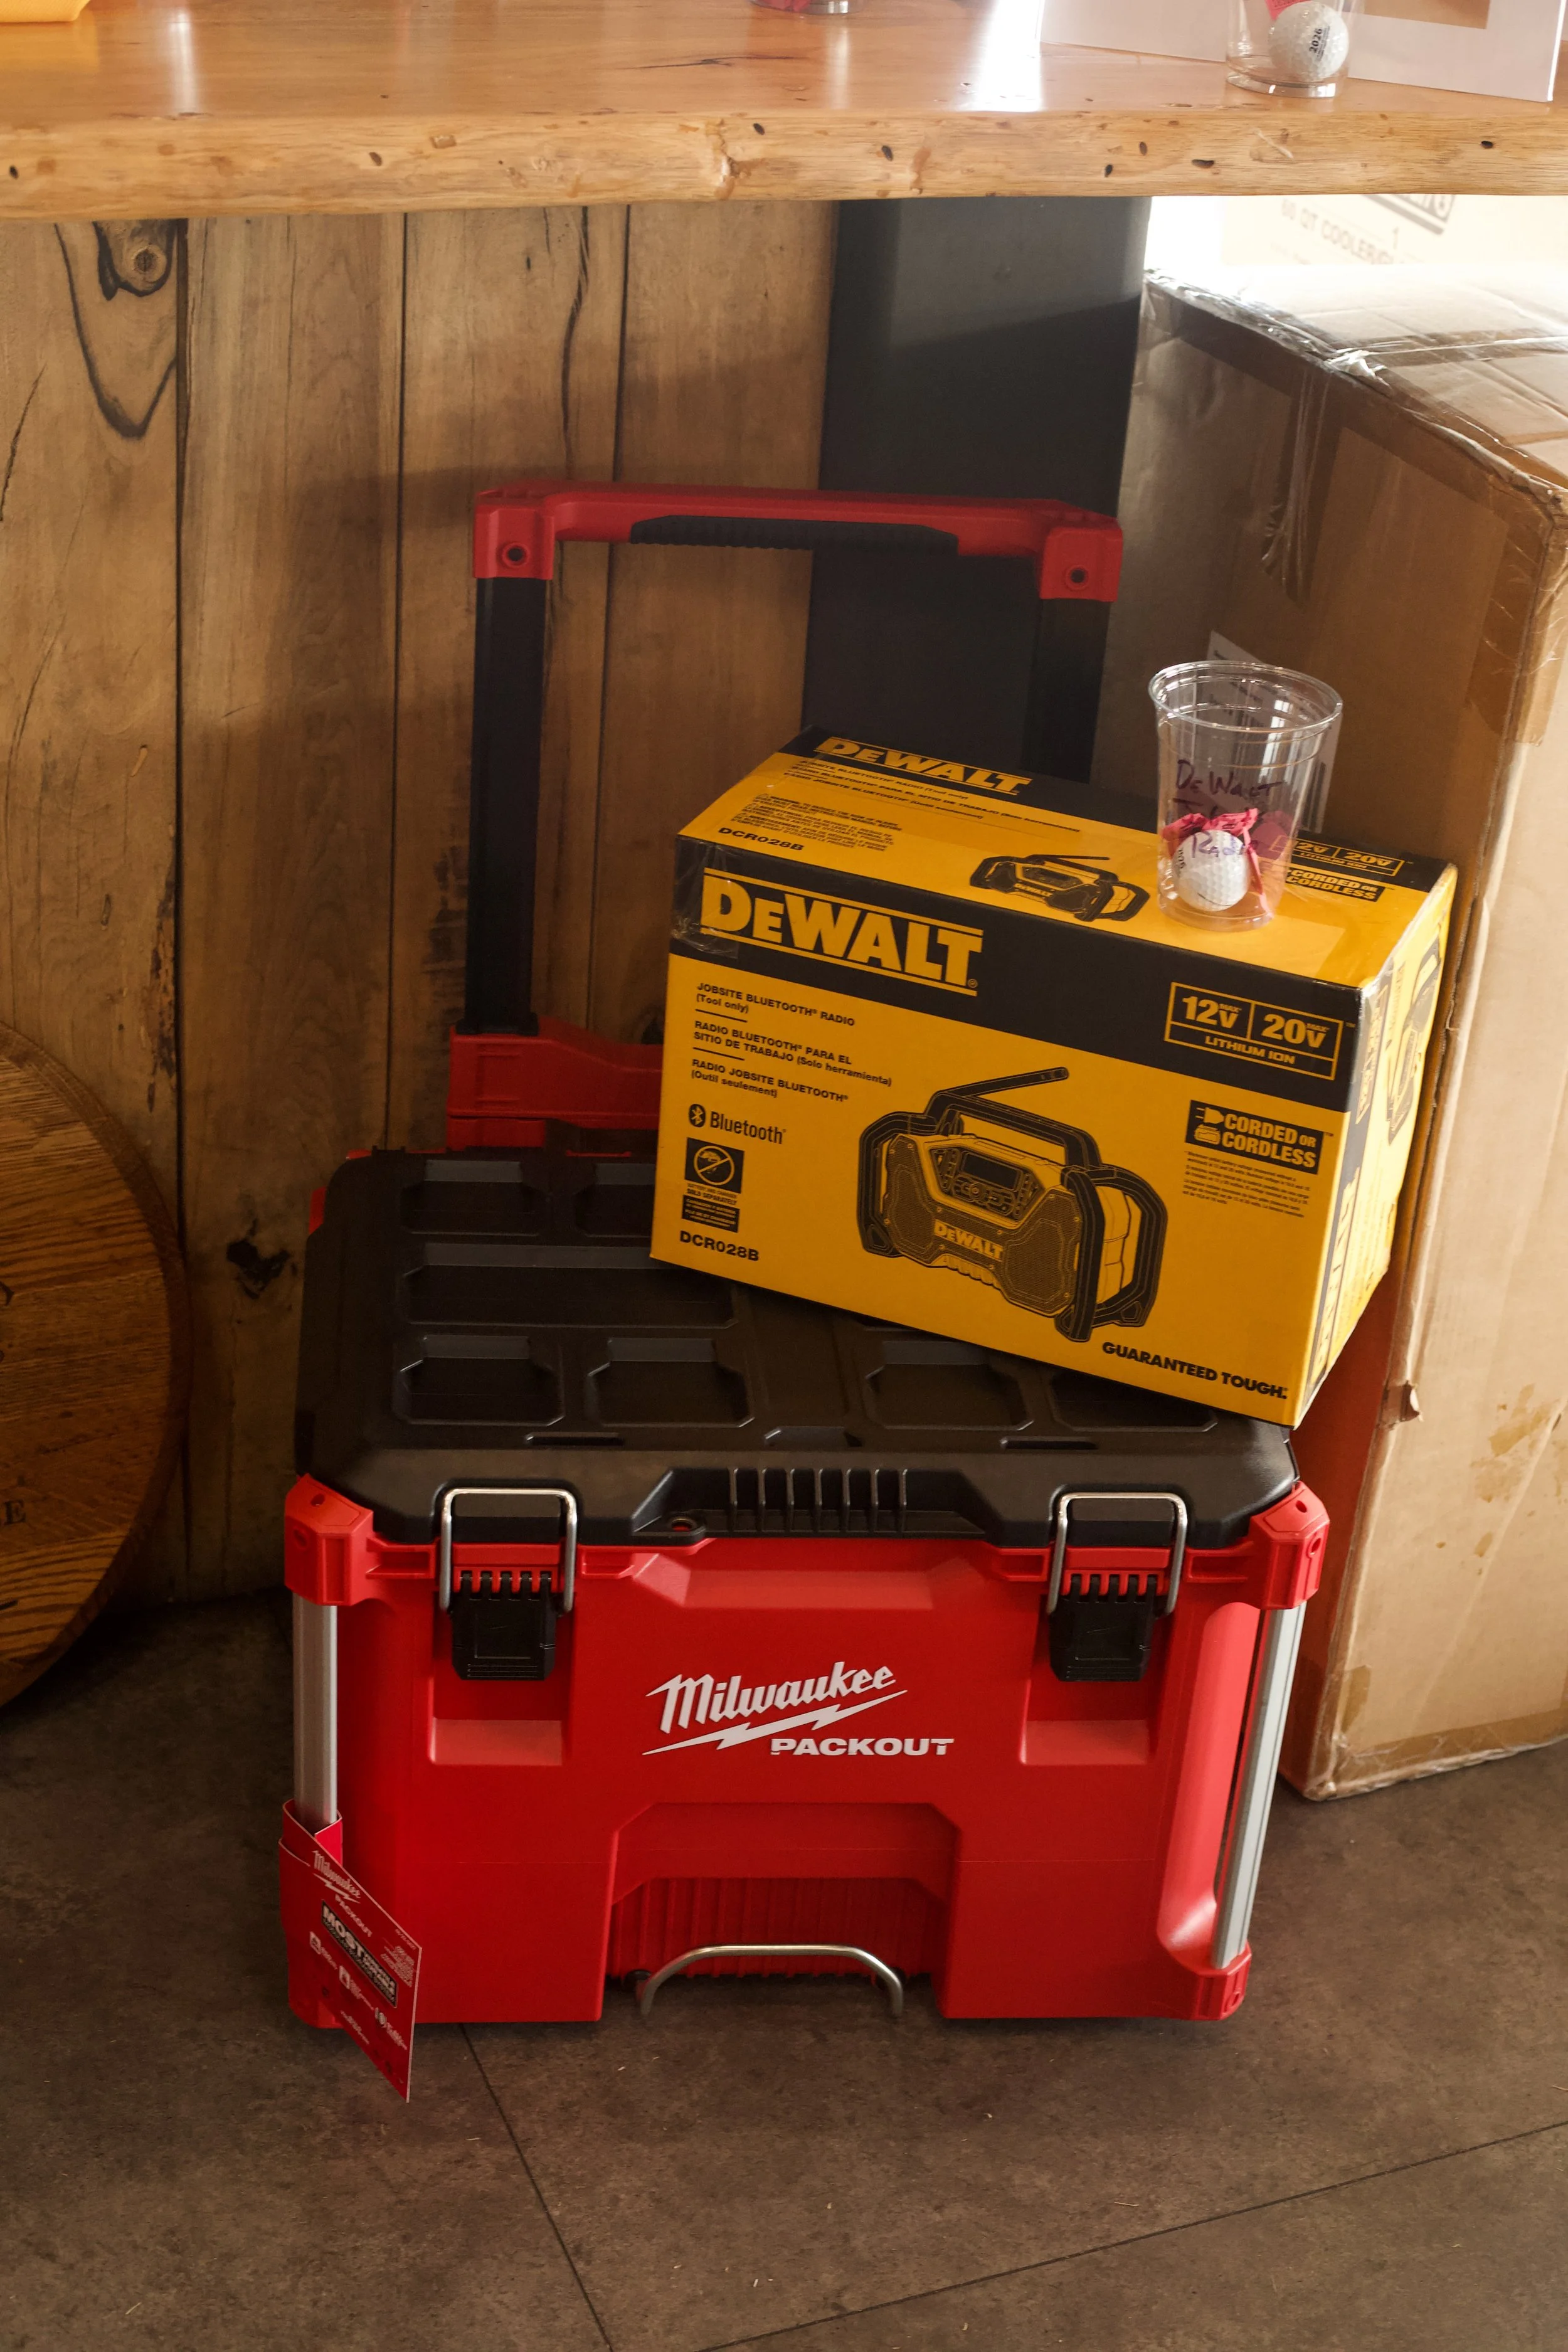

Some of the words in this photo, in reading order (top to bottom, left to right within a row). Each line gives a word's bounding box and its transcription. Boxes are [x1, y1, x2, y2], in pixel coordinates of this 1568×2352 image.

[817, 738, 1030, 794] DEWALT
[718, 827, 805, 851] DCR028B
[1292, 841, 1329, 854] 2V
[1344, 852, 1394, 867] 20V
[1286, 876, 1377, 899] CORDLESS
[1291, 869, 1360, 888] CORDED
[696, 993, 721, 1006] (Tool
[724, 1002, 749, 1014] only)
[697, 982, 743, 1000] JOBSITE
[820, 1011, 856, 1026] RADIO
[694, 1020, 728, 1035] RADIO
[805, 1046, 835, 1061] PARA
[838, 1054, 852, 1065] EL
[1204, 1036, 1266, 1057] LITHIUM
[1268, 1051, 1296, 1064] ION
[692, 1059, 726, 1073] RADIO
[729, 1068, 775, 1085] JOBSITE
[694, 1031, 722, 1044] SITIO
[725, 1039, 740, 1049] DE
[744, 1042, 794, 1062] TRABAJO
[797, 1056, 822, 1069] (Solo
[825, 1063, 892, 1088] herramienta)
[691, 1069, 719, 1083] (Outil
[721, 1078, 778, 1098] seulement)
[1224, 1113, 1298, 1145] CORDED
[1299, 1134, 1316, 1148] OR
[1222, 1131, 1317, 1168] CORDLESS
[680, 1230, 759, 1261] DCR028B
[934, 1219, 1004, 1259] DEWALT
[1102, 1341, 1218, 1381] GUARANTEED
[645, 1661, 896, 1734] Milwaukee
[770, 1738, 955, 1756] PACKOUT
